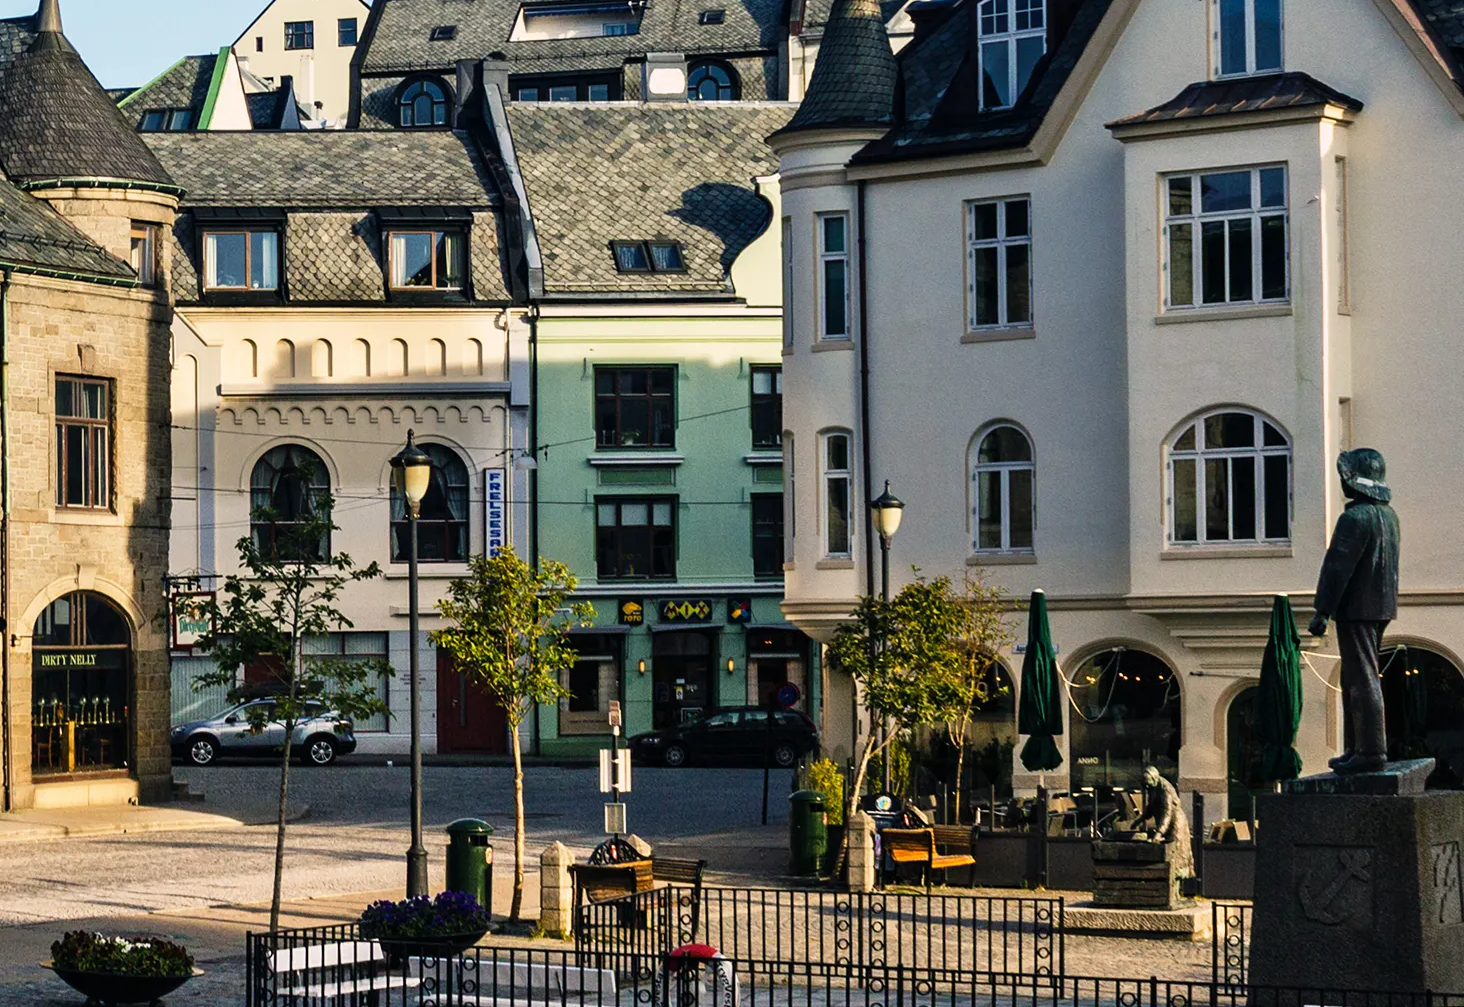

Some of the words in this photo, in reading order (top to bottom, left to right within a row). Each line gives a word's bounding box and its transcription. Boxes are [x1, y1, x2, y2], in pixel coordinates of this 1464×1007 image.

[663, 601, 710, 618] MIX
[41, 654, 67, 666] DIRTY
[70, 654, 96, 666] NELLY
